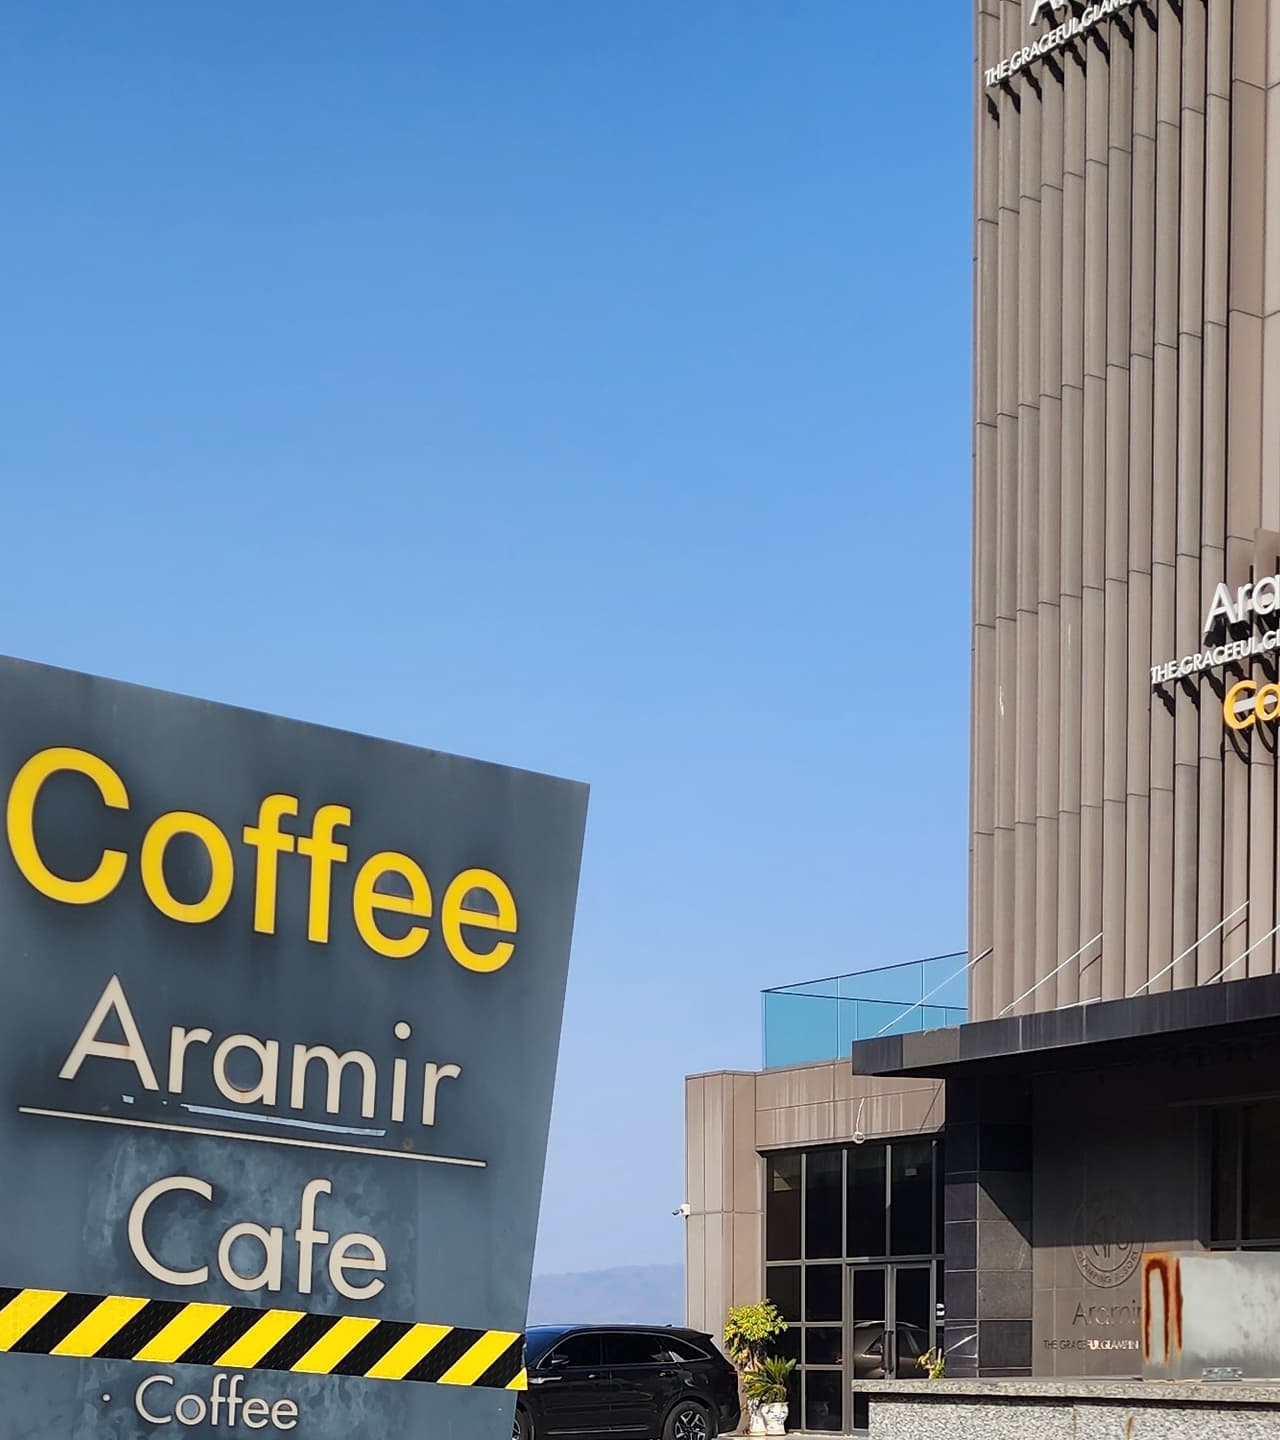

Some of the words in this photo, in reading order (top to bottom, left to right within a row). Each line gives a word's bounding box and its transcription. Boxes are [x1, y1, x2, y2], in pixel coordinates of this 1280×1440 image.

[984, 62, 1010, 87] THE
[1009, 17, 1083, 72] GRACEFUL
[1150, 659, 1178, 684] THE
[1178, 638, 1262, 676] GRACEFUL
[6, 746, 518, 974] Coffee
[57, 973, 462, 1127] Aramir
[127, 1175, 388, 1300] Cafe
[135, 1373, 299, 1430] Coffee
